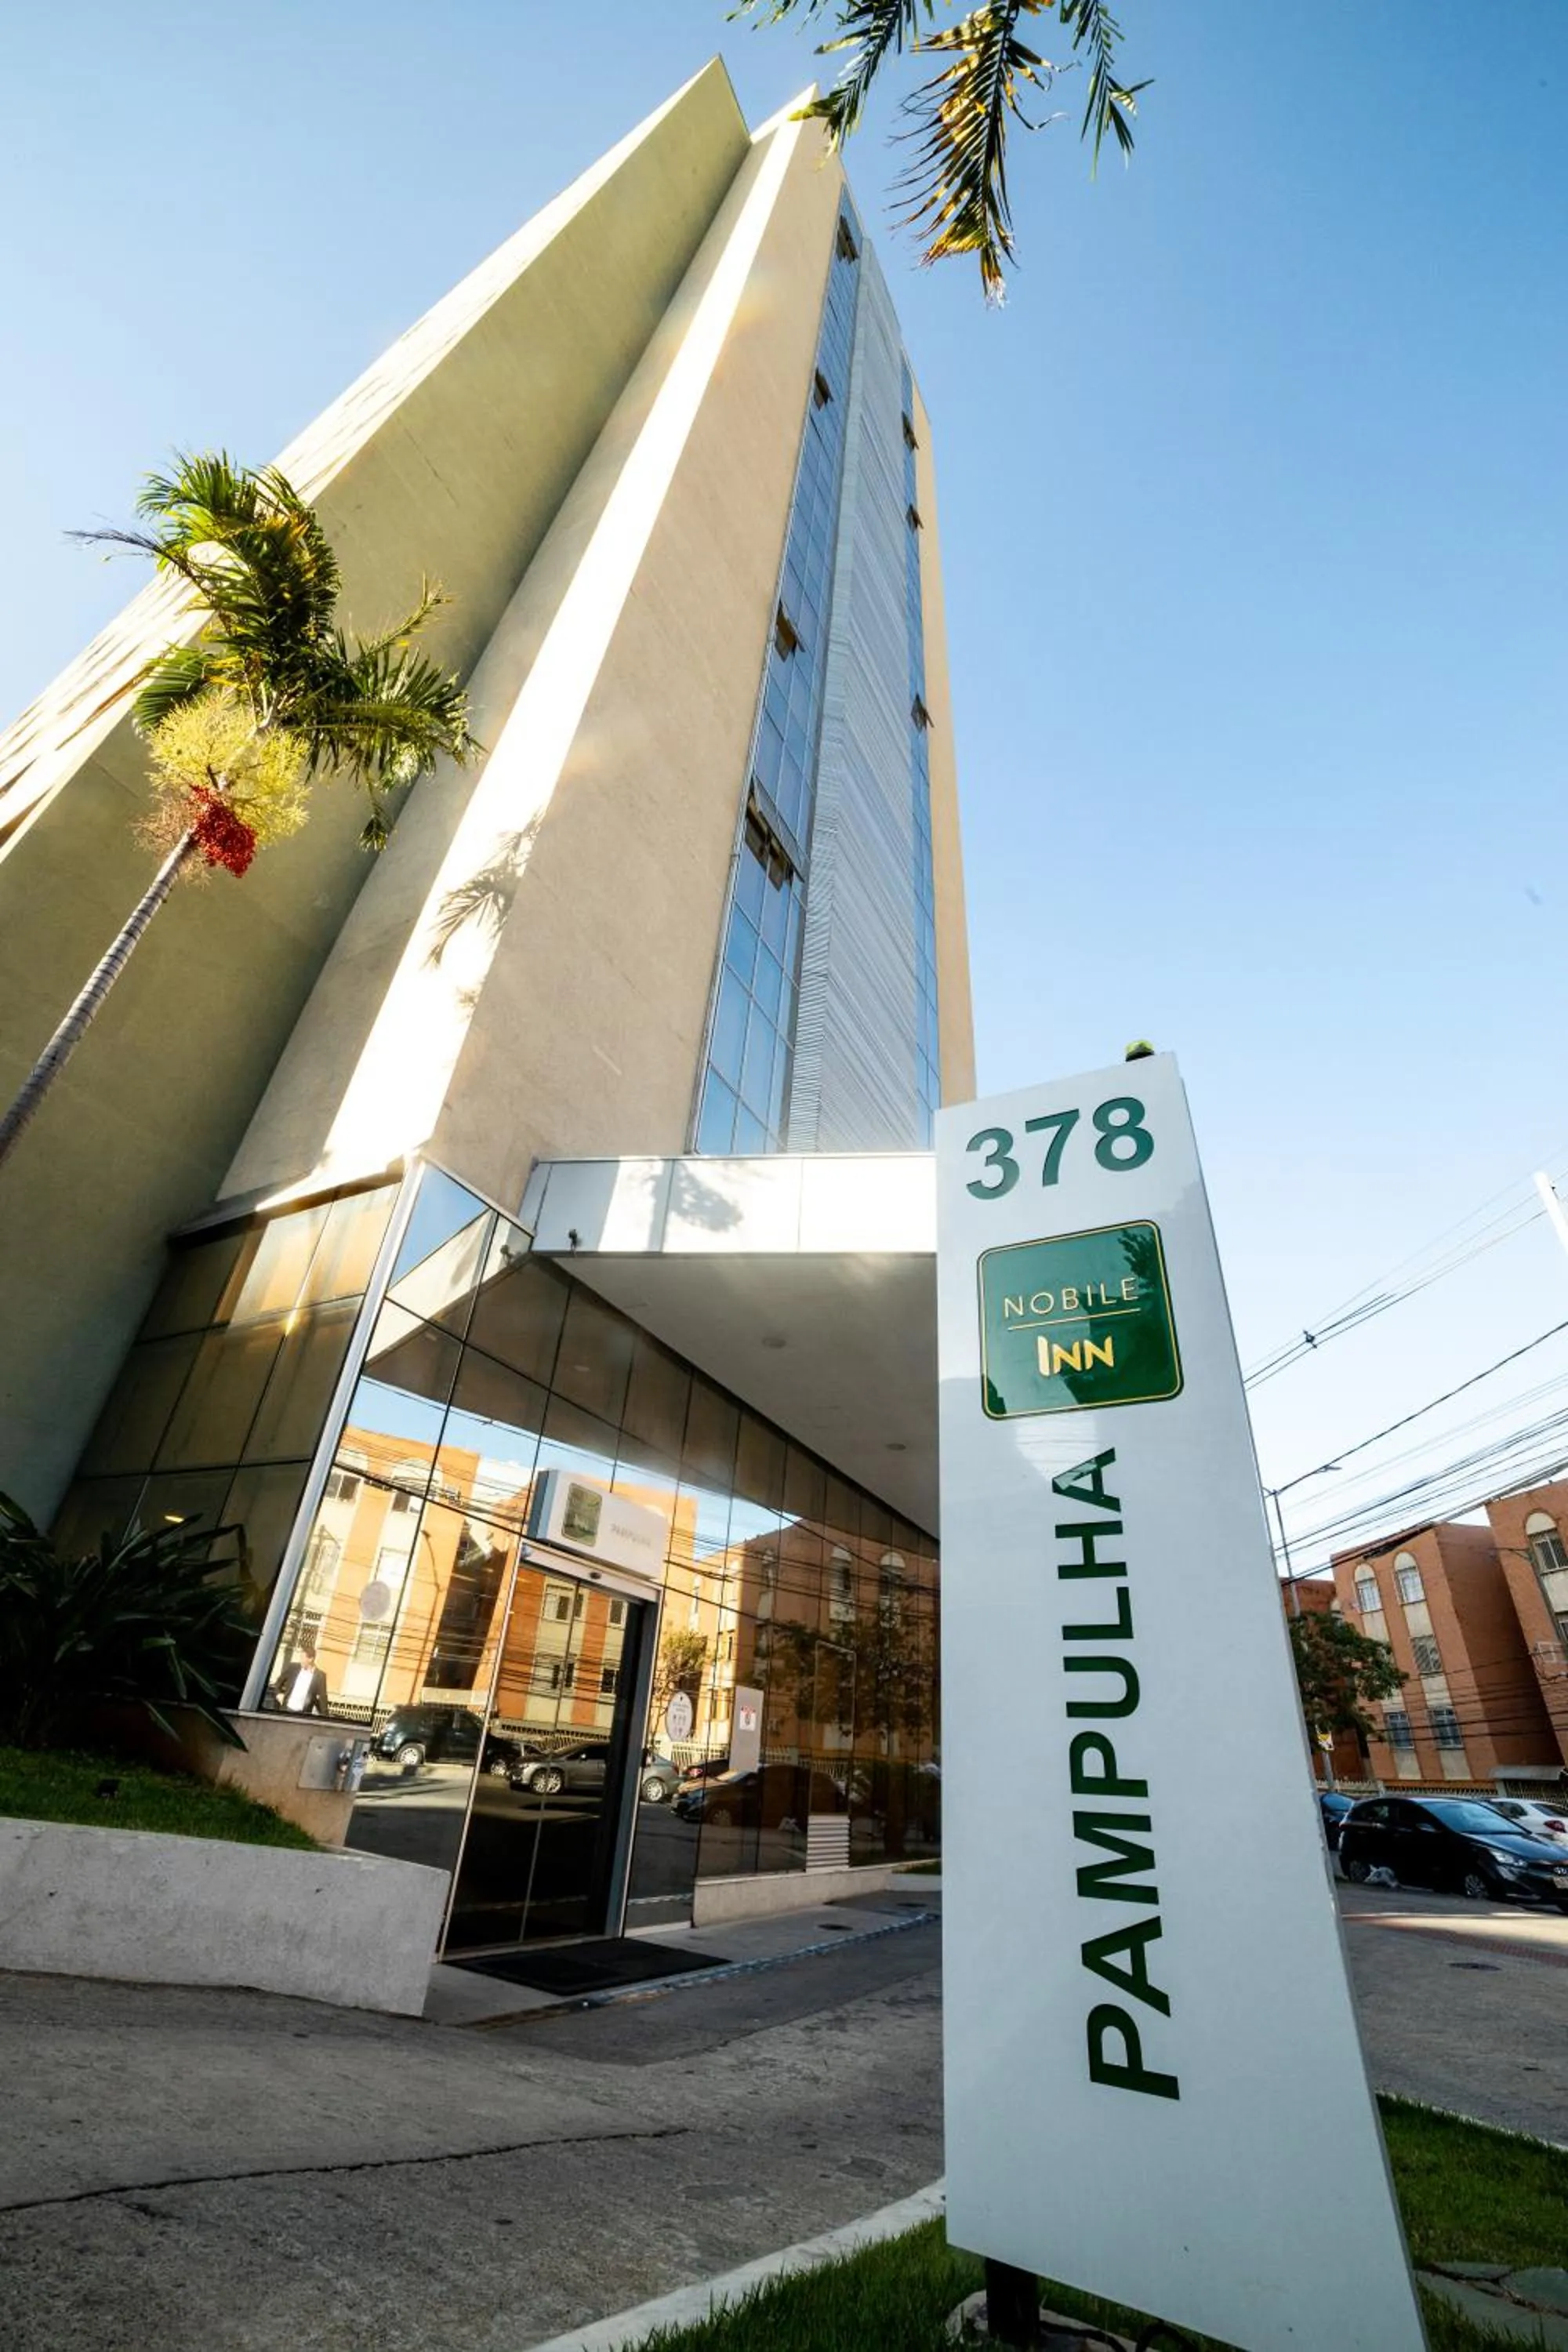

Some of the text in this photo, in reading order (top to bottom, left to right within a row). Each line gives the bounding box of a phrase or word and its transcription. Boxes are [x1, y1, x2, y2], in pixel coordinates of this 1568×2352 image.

[966, 1097, 1154, 1200] 378
[1004, 1278, 1139, 1319] NOBILE
[1052, 1447, 1180, 2100] PAMPULHA
